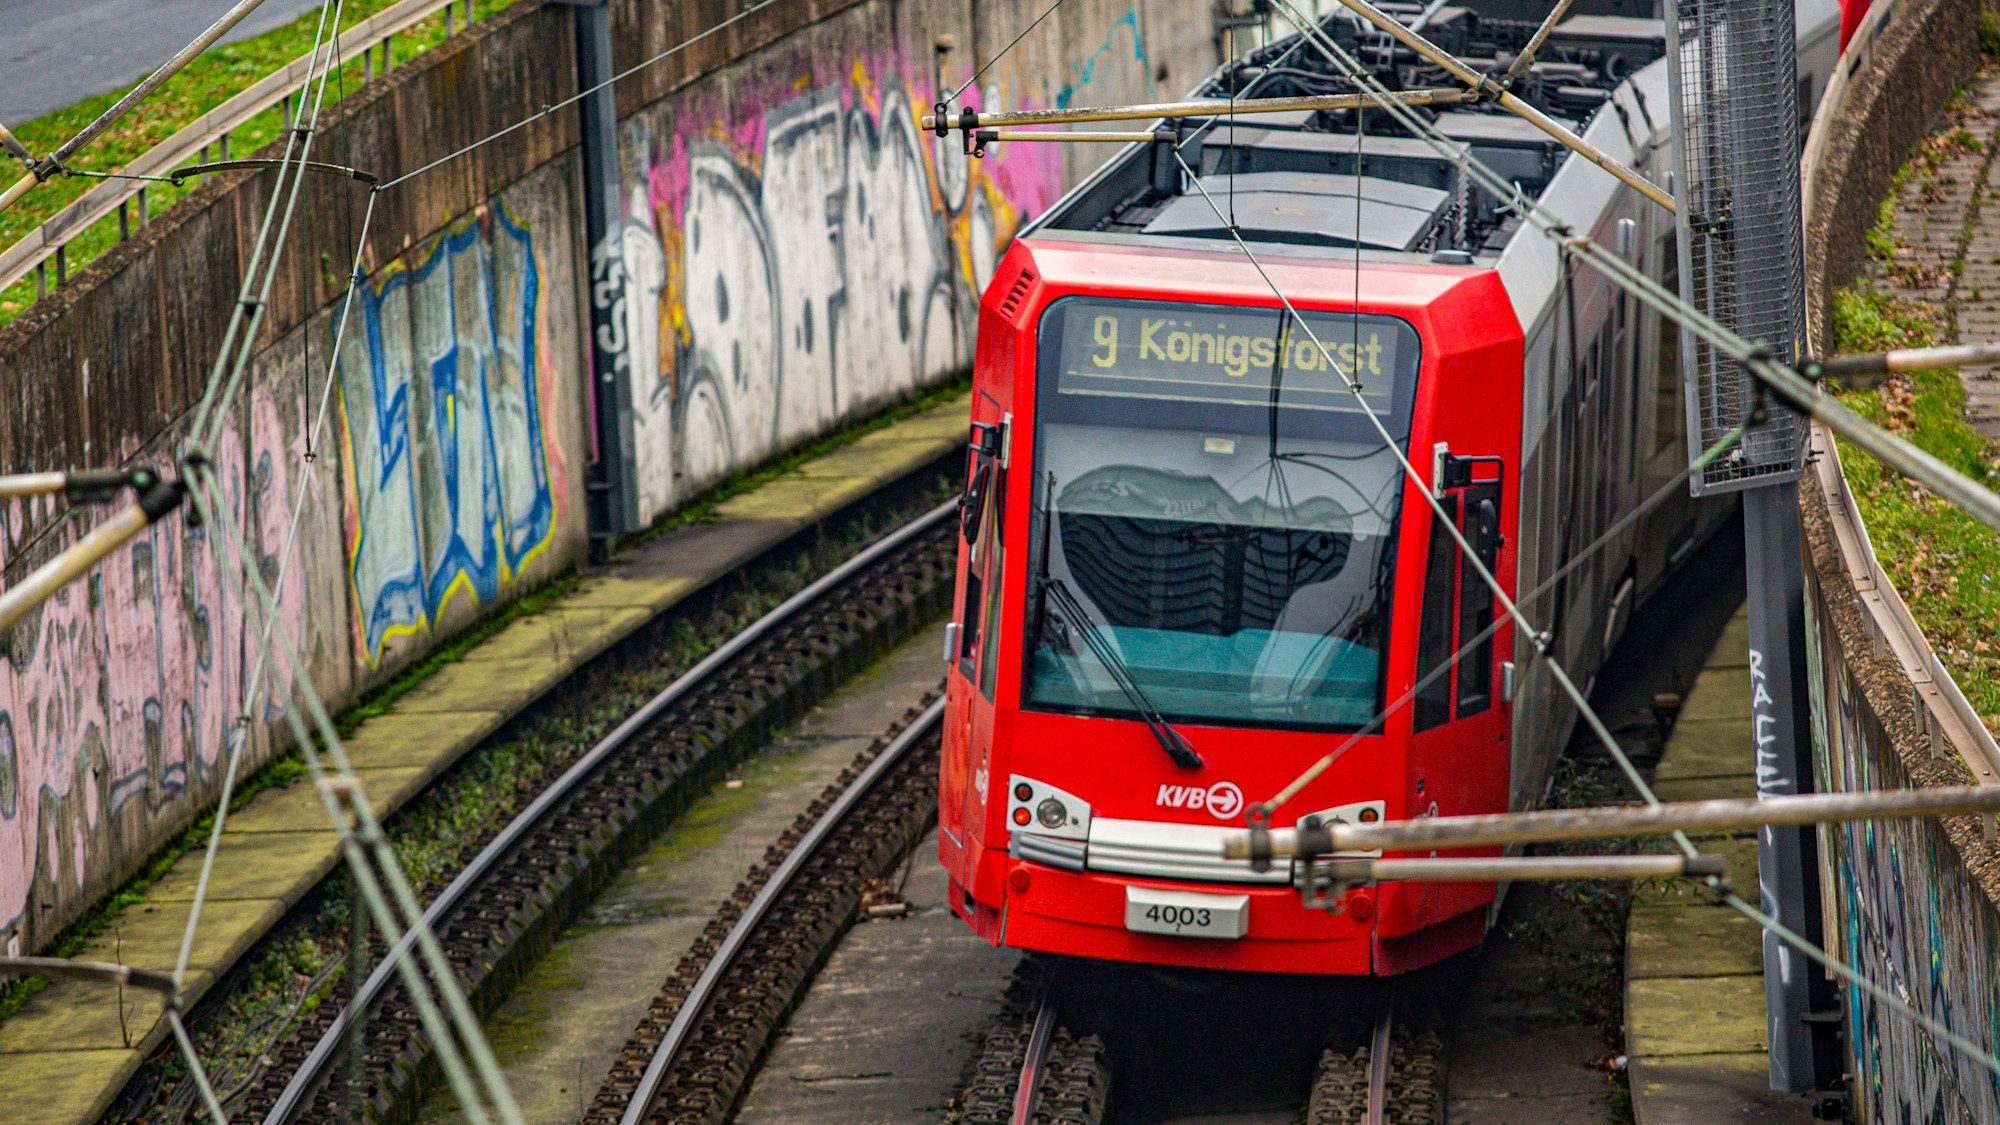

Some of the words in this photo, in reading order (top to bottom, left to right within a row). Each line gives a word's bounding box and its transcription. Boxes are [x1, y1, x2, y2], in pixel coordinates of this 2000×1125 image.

[1092, 315, 1118, 368] 9
[1139, 317, 1383, 377] Königsforst
[1155, 783, 1207, 809] KVB
[1145, 904, 1212, 927] 4003
